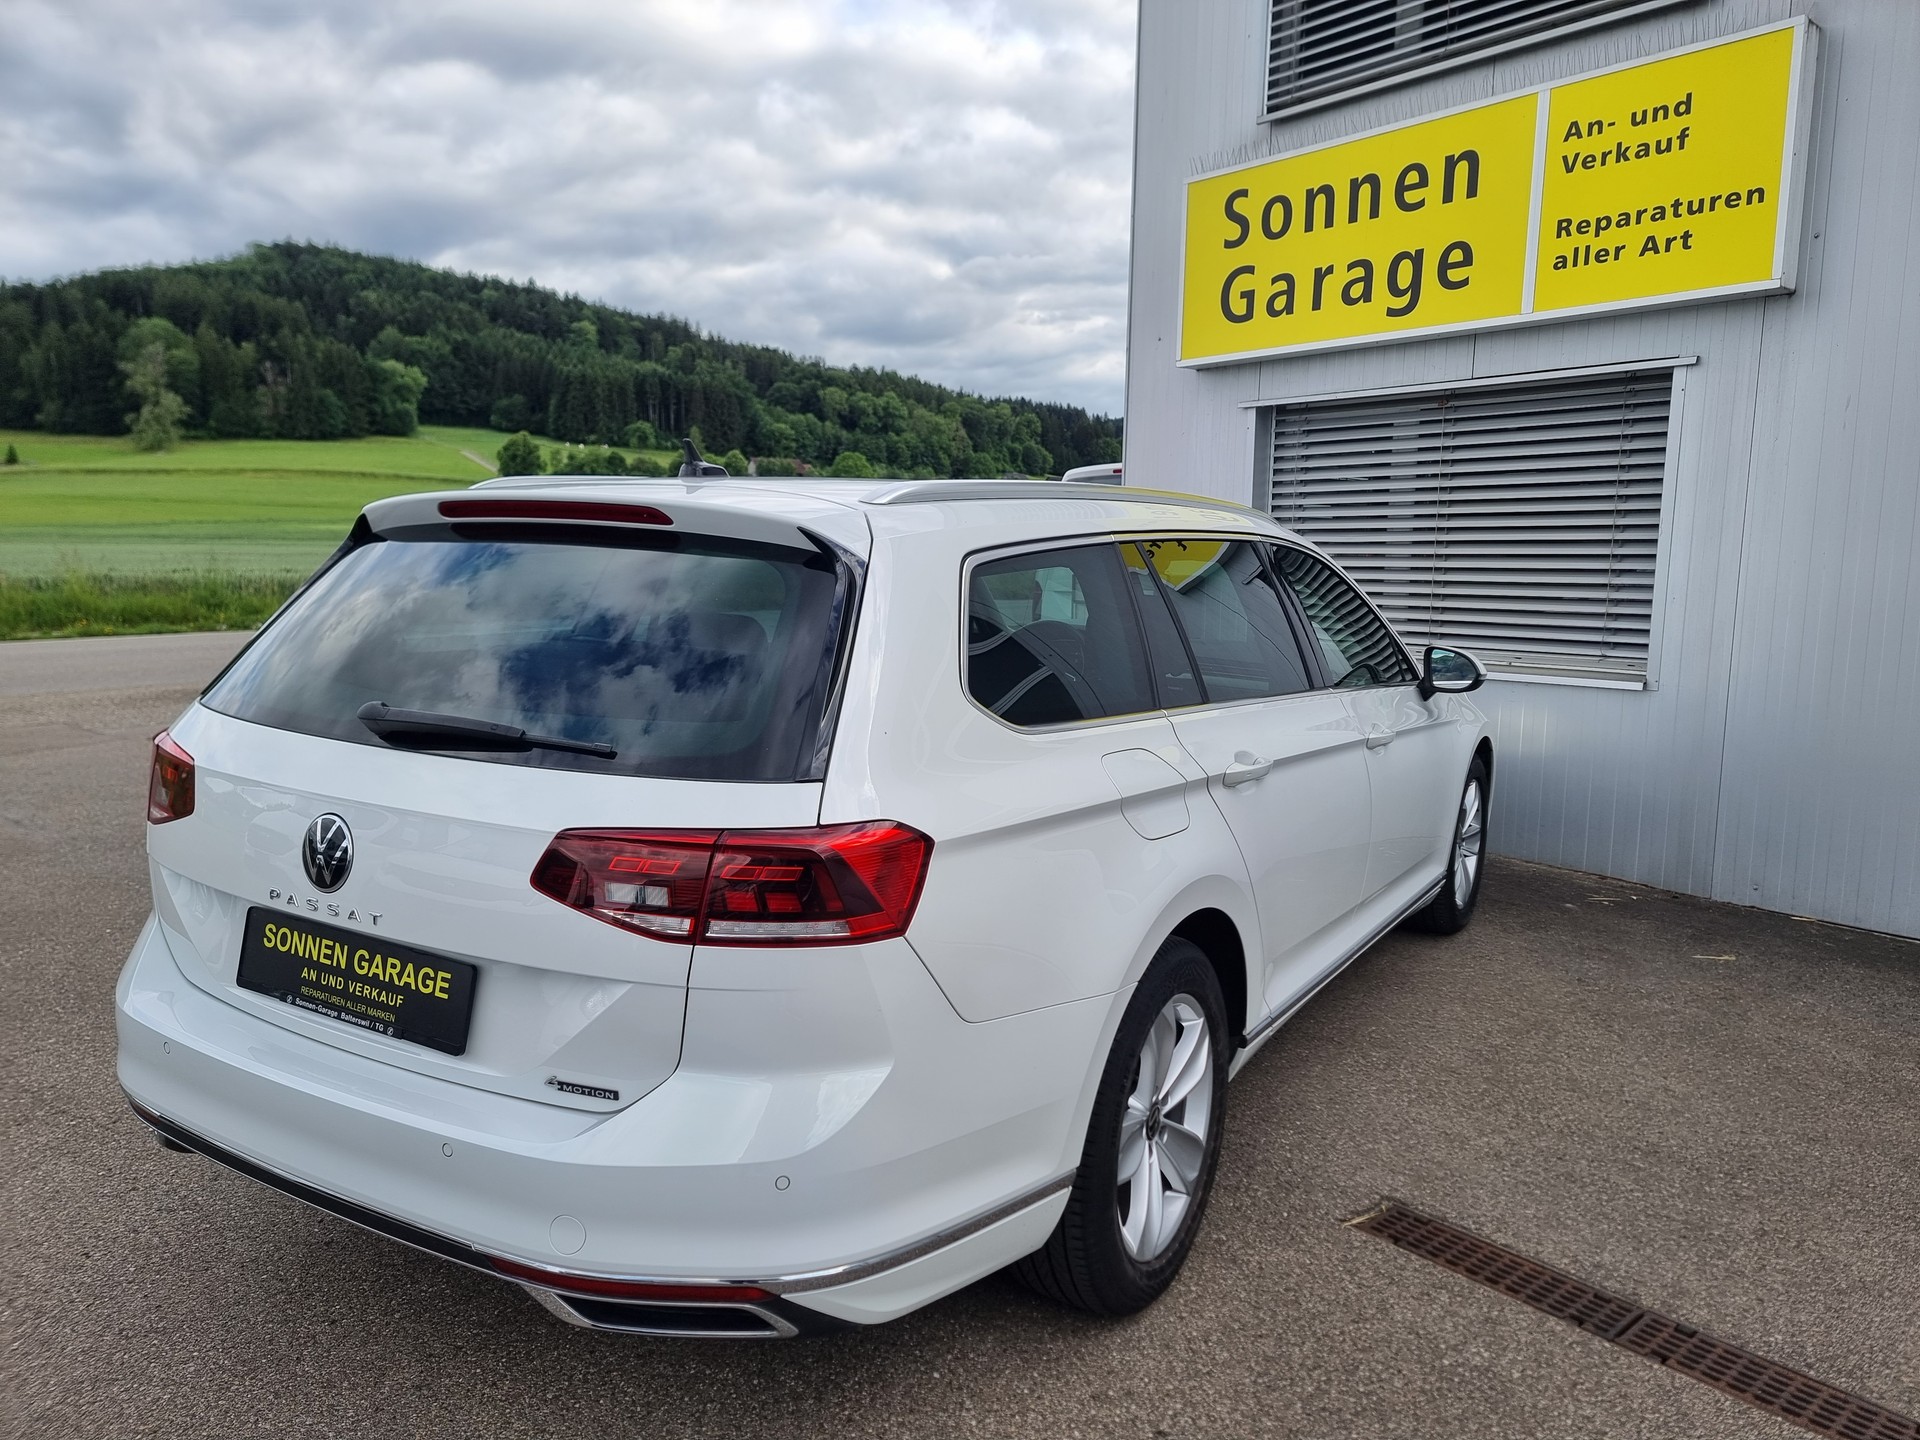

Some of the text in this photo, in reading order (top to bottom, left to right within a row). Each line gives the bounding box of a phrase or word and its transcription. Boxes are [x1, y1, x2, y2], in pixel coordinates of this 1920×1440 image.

[1562, 92, 1693, 143] An- und
[1561, 127, 1691, 174] Verkauf
[1223, 149, 1480, 250] Sonnen
[1555, 187, 1765, 240] Reparaturen
[1552, 229, 1693, 271] aller Art
[1220, 240, 1474, 323] Garage
[269, 887, 383, 926] PASSAT
[263, 923, 452, 999] SONNEN GARAGE
[301, 967, 404, 1008] AN UND VERKAUF
[301, 986, 396, 1023] REPARATUREN ALLER MARKEN
[295, 997, 338, 1018] Sonnen-Garage
[375, 1022, 384, 1032] TG
